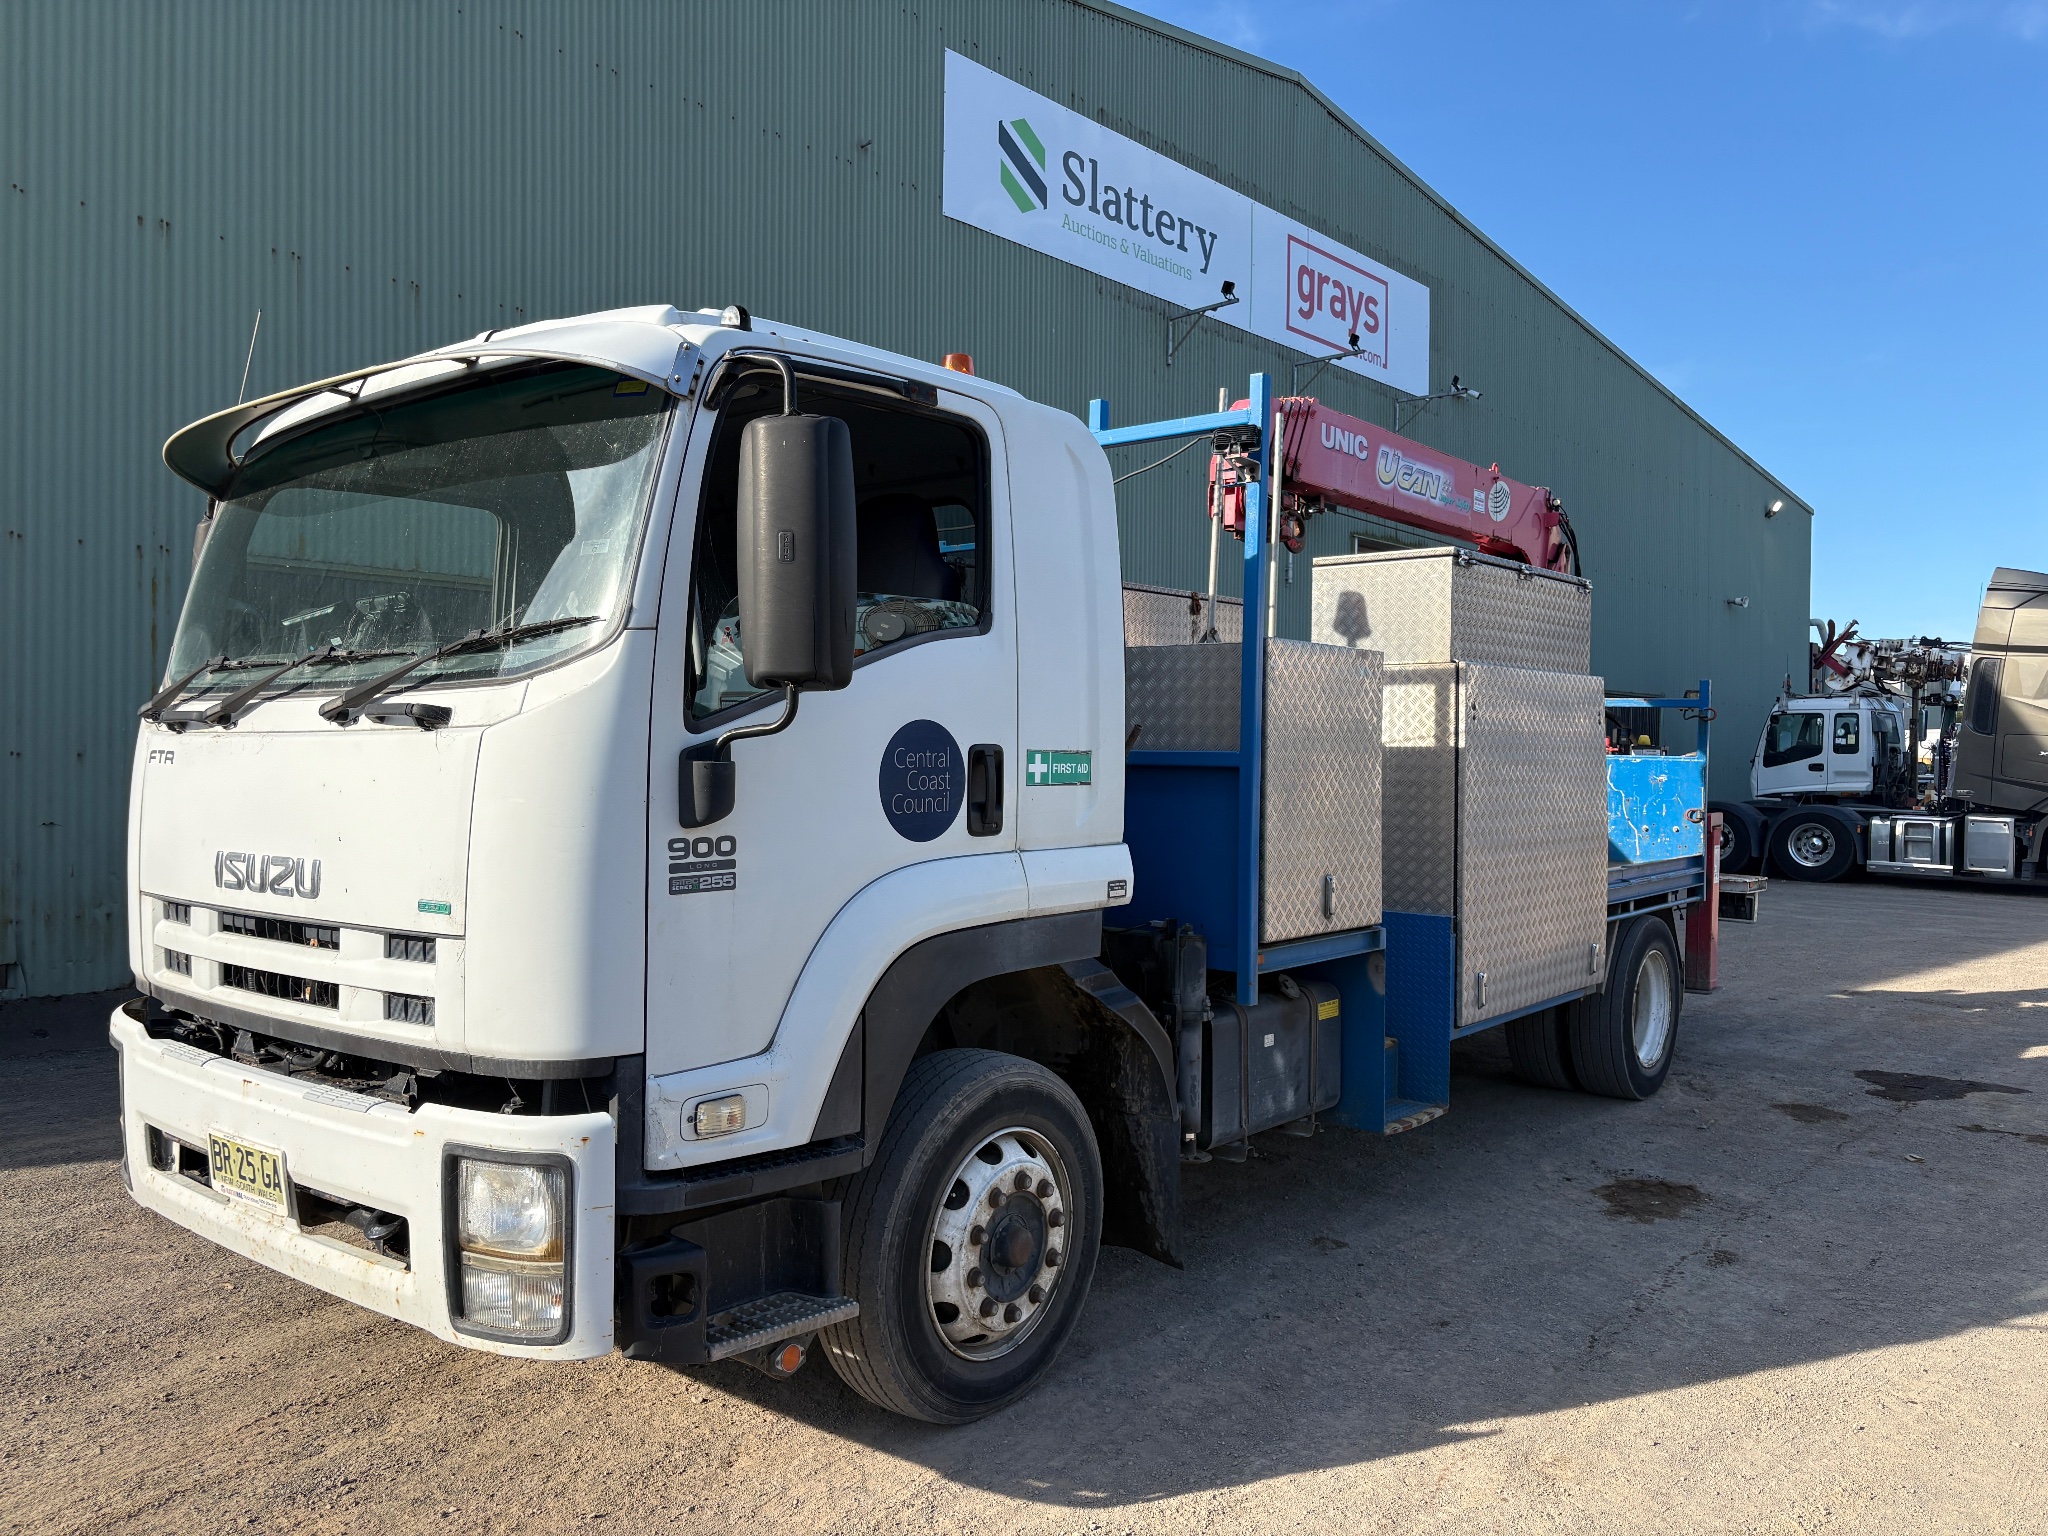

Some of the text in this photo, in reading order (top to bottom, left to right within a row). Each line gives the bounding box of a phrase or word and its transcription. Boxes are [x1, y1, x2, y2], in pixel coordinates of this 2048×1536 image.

[1062, 150, 1218, 275] Slattery
[1061, 213, 1193, 281] Auctions & Valuations
[1297, 264, 1380, 338] grays
[1321, 422, 1369, 461] UNIC
[148, 749, 175, 765] FTR
[894, 746, 950, 769] Central
[1052, 762, 1089, 774] FIRST AID
[907, 769, 951, 791] Coast
[891, 791, 950, 815] Council
[668, 835, 737, 861] 900
[214, 850, 322, 900] ISUZU
[689, 862, 718, 870] LONG
[699, 875, 735, 890] 255
[220, 1174, 278, 1202] NEW SOUTH WALES
